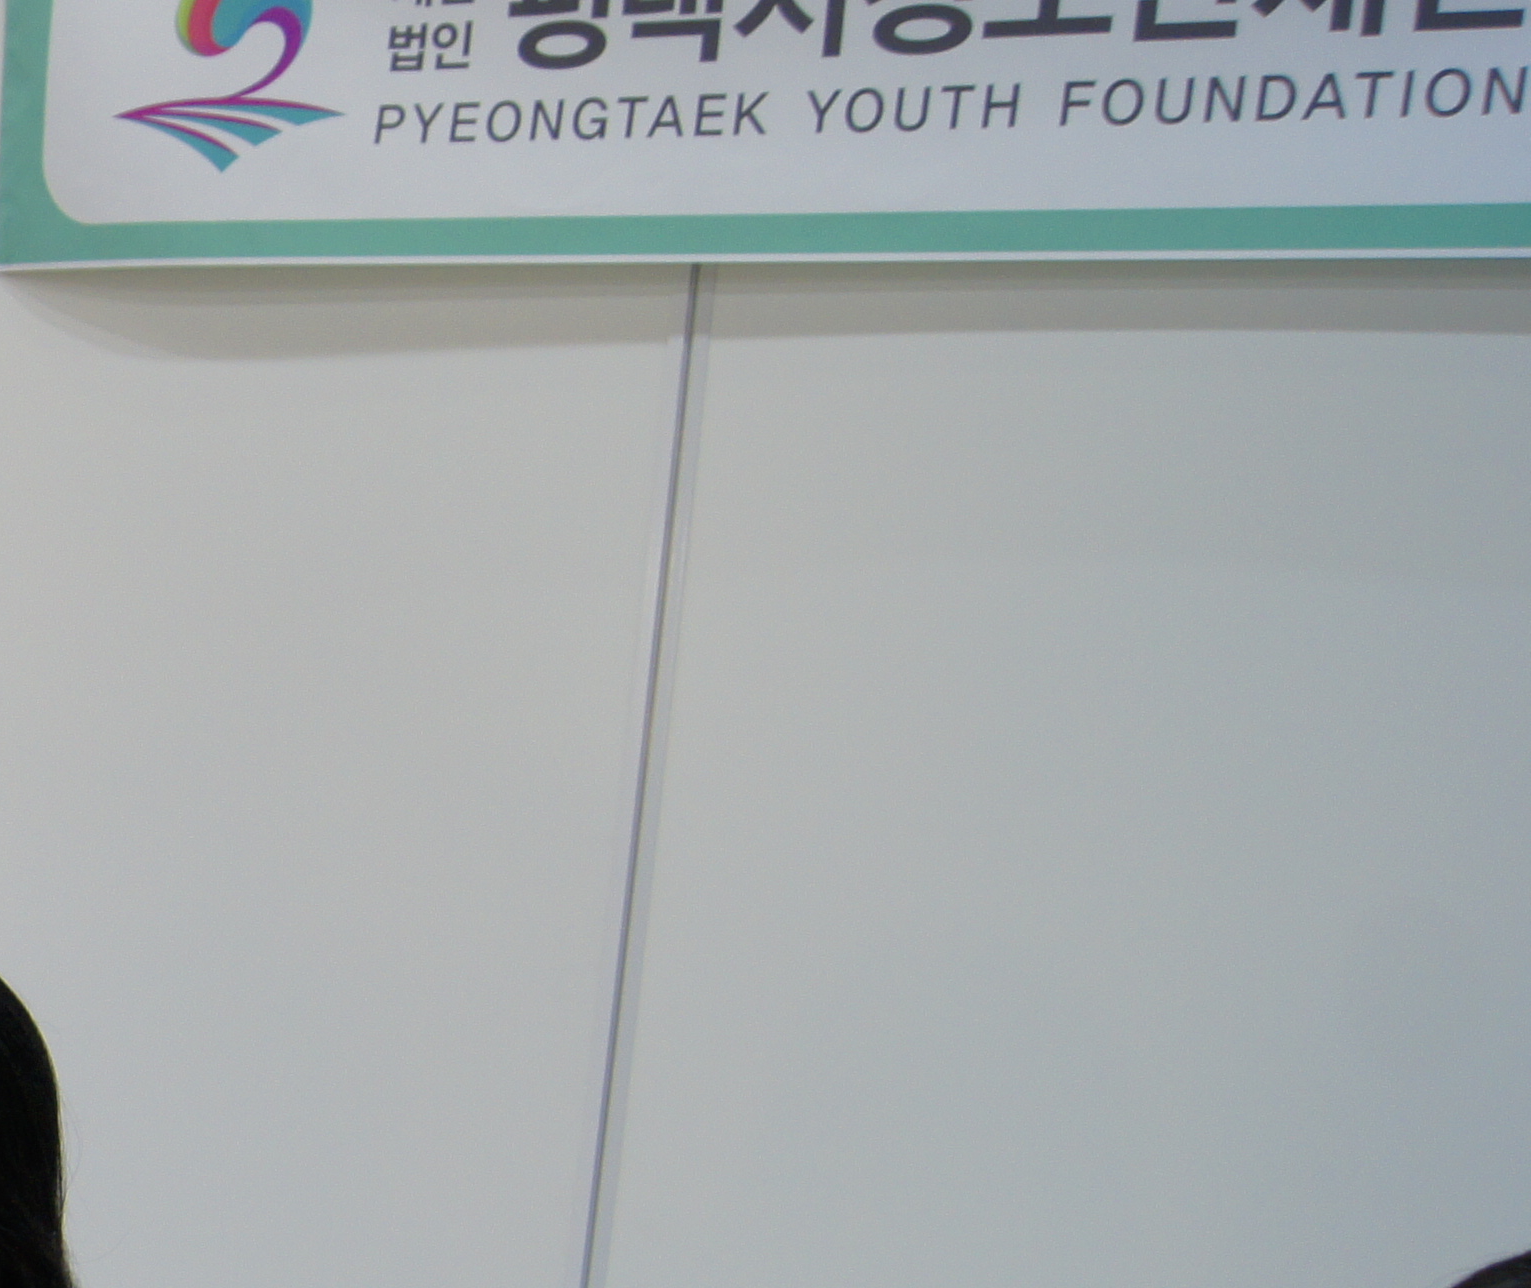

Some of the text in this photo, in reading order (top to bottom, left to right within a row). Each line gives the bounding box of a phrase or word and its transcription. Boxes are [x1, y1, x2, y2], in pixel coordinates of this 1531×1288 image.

[387, 20, 475, 73] 법인
[506, 0, 1526, 70] 평택시청
[373, 65, 1531, 146] PYEONGTAEK YOUTH FOUNDATION
